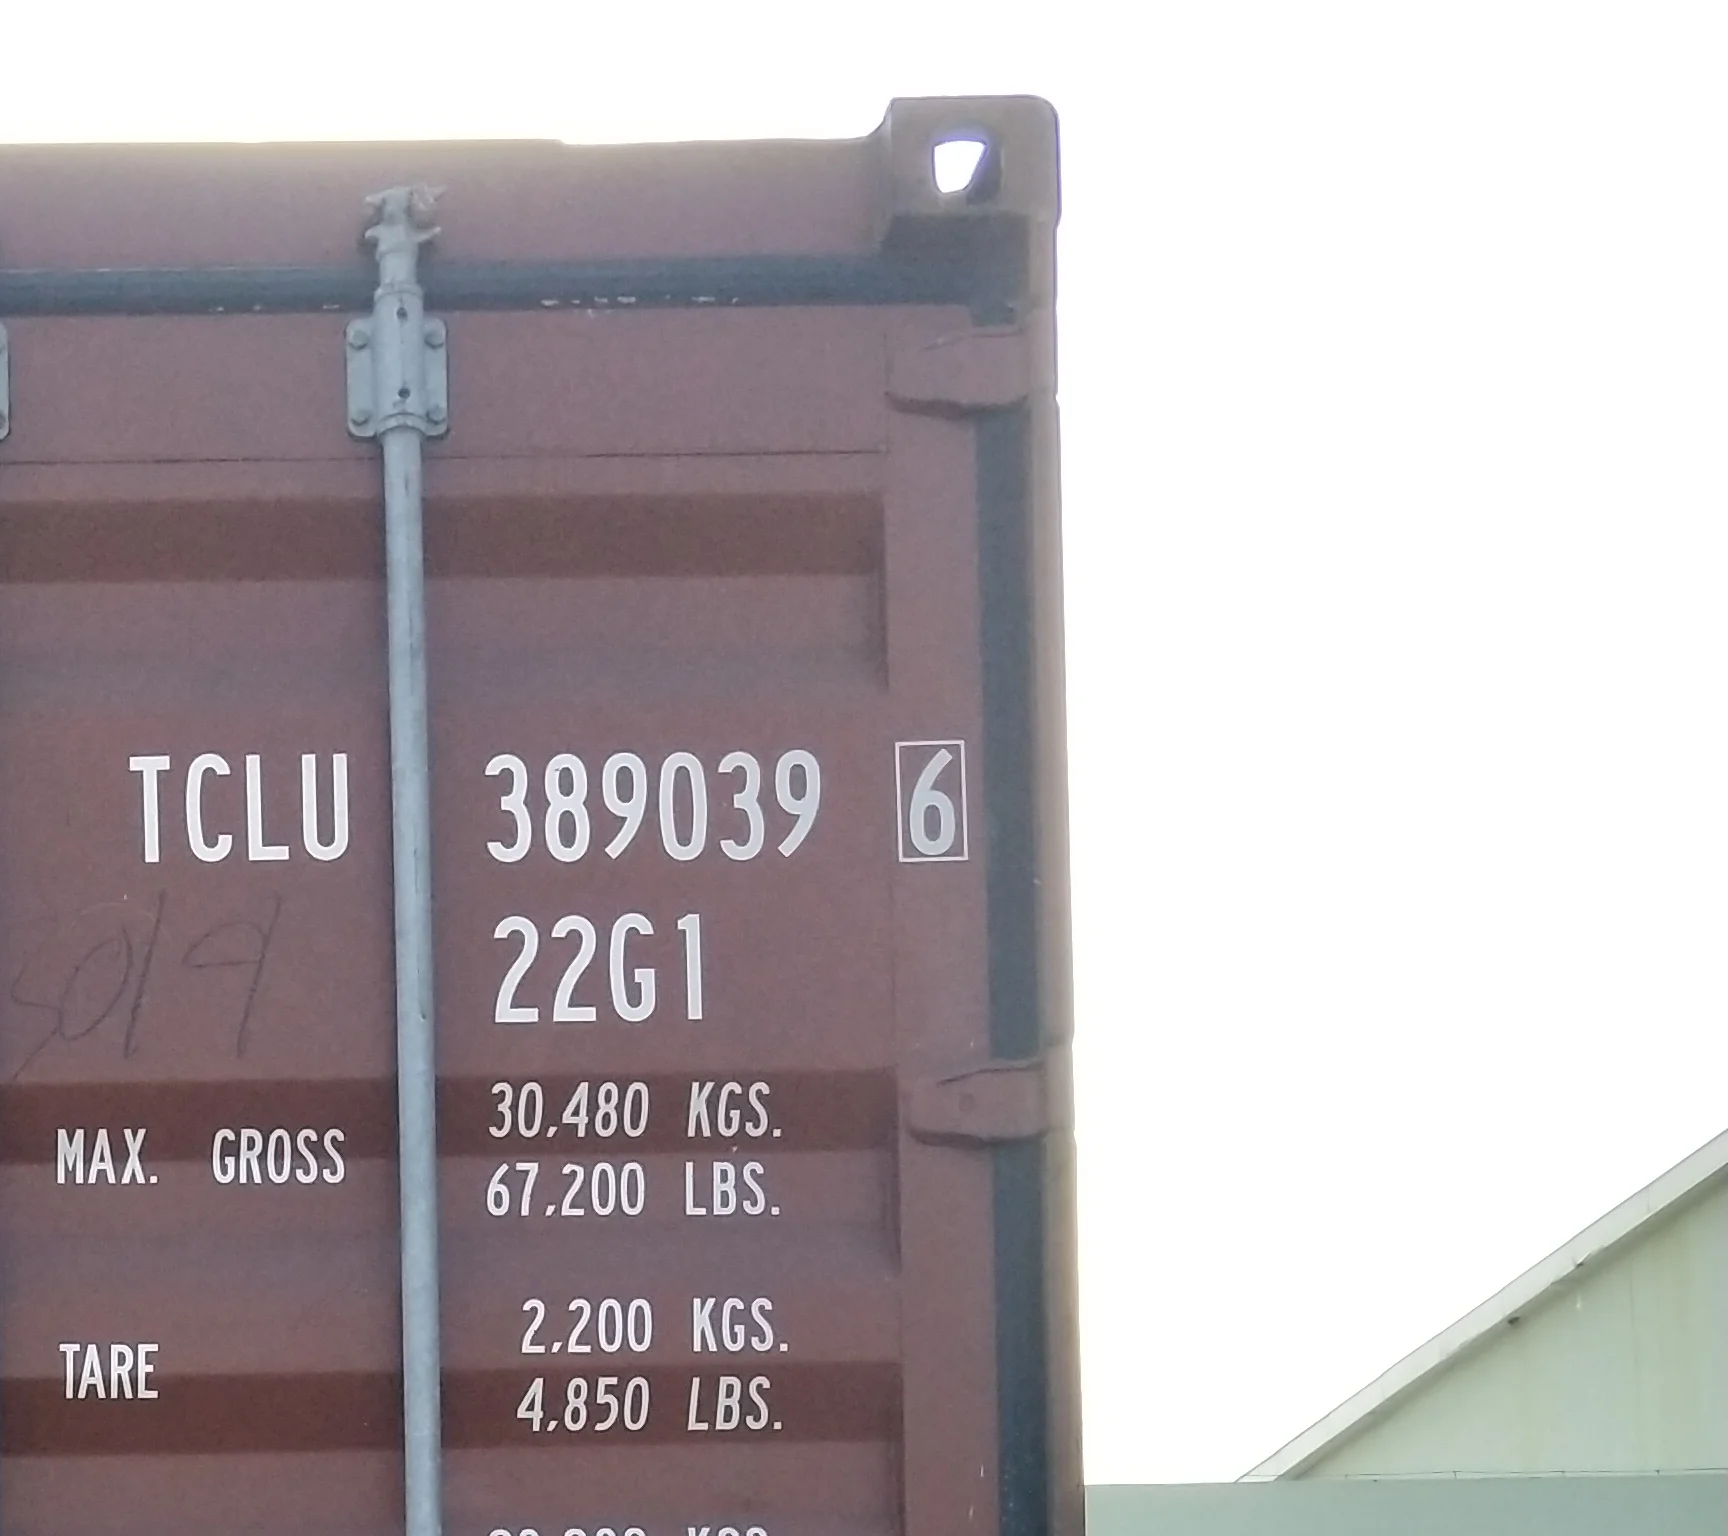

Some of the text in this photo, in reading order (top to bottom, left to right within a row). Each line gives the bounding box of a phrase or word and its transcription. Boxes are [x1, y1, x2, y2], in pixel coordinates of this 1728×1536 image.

[129, 748, 957, 863] TCLU 389039 6
[493, 912, 703, 1023] 22G1
[488, 1081, 782, 1138] 30,480 KGS.
[56, 1128, 345, 1185] MAX. GROSS
[486, 1161, 780, 1217] 67,200 LBS.
[521, 1297, 788, 1354] 2,200 KGS.
[59, 1343, 159, 1399] TARE
[516, 1375, 782, 1432] 4,850 LBS.
